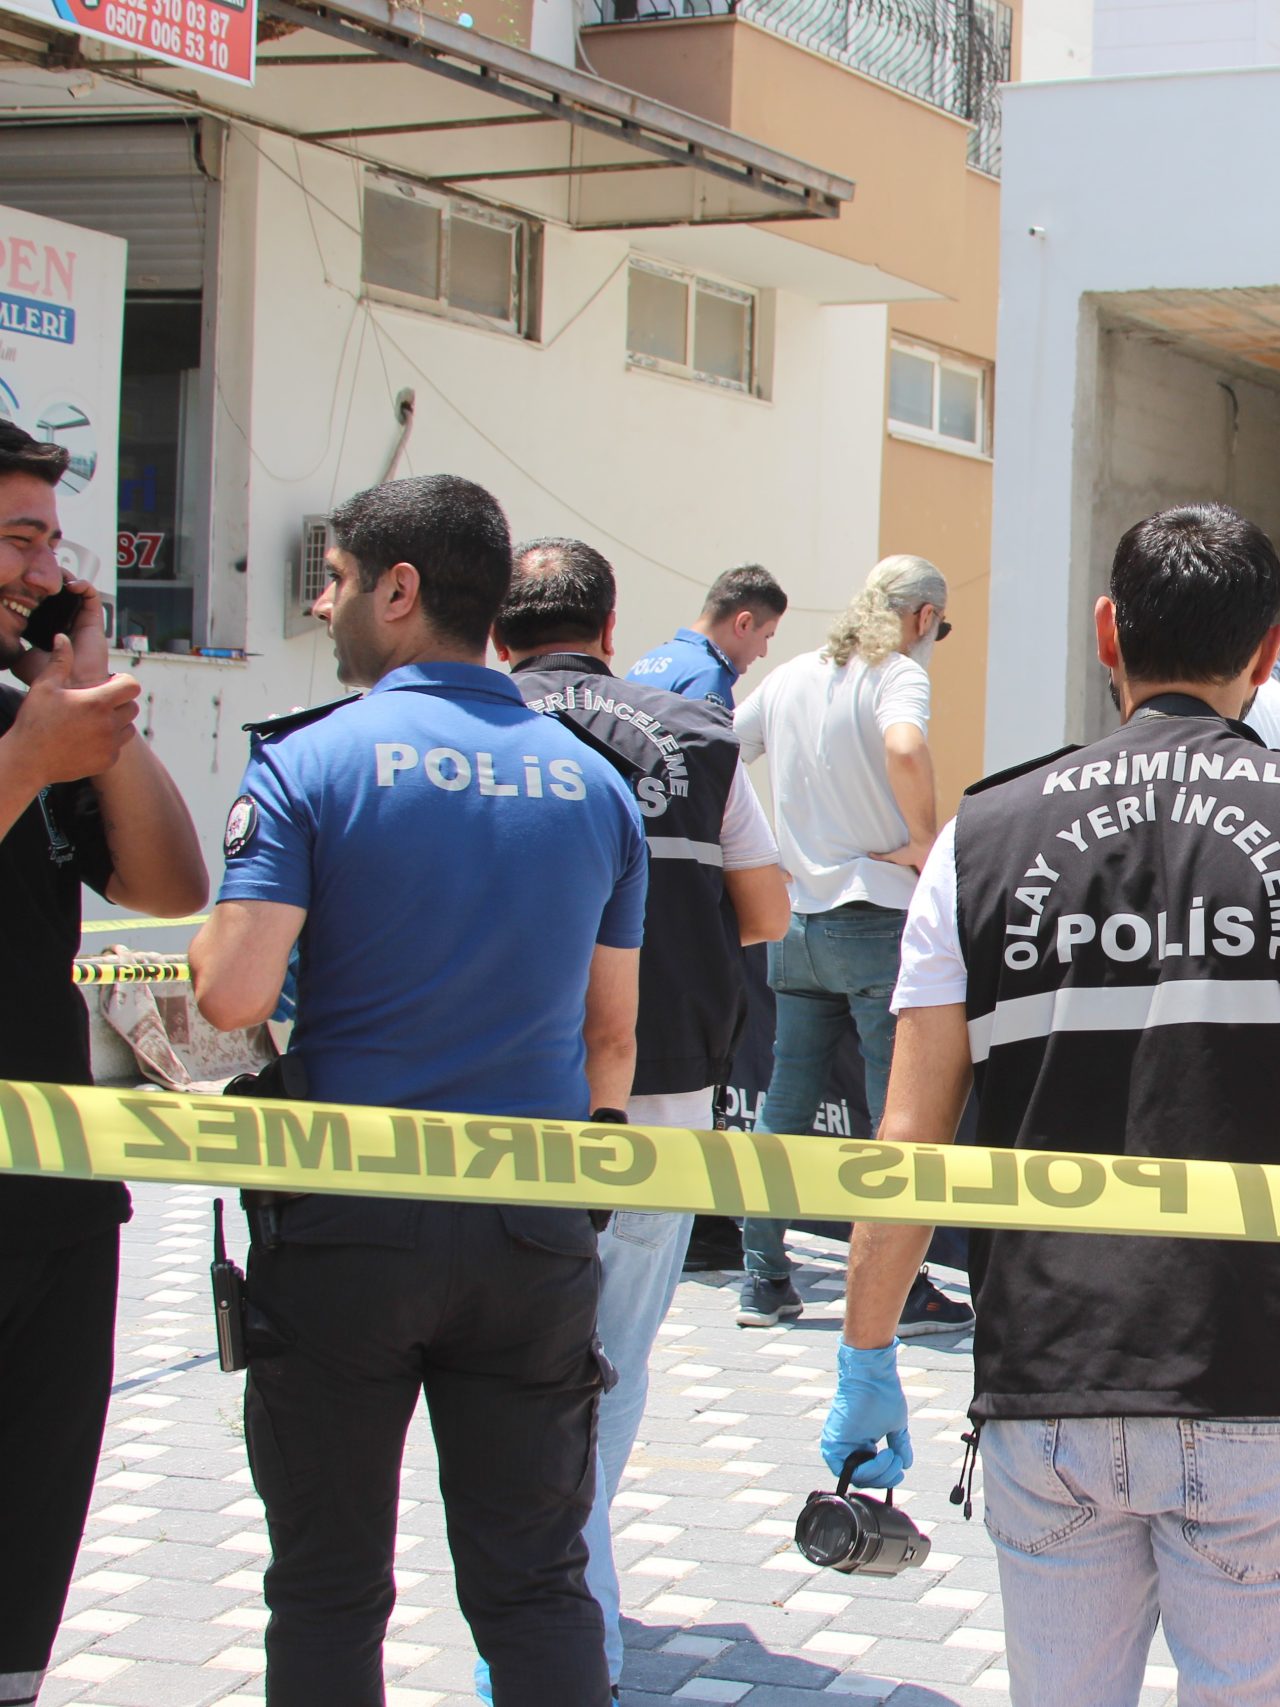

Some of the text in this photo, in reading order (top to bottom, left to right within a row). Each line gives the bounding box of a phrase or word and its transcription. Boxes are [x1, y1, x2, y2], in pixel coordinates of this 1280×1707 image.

[105, 3, 229, 70] 0507 006 53 10
[186, 1, 206, 31] 03
[210, 9, 230, 39] 87
[1004, 852, 1060, 971] OLAY
[1056, 783, 1156, 853] YERİ
[1056, 897, 1256, 963] POLİS
